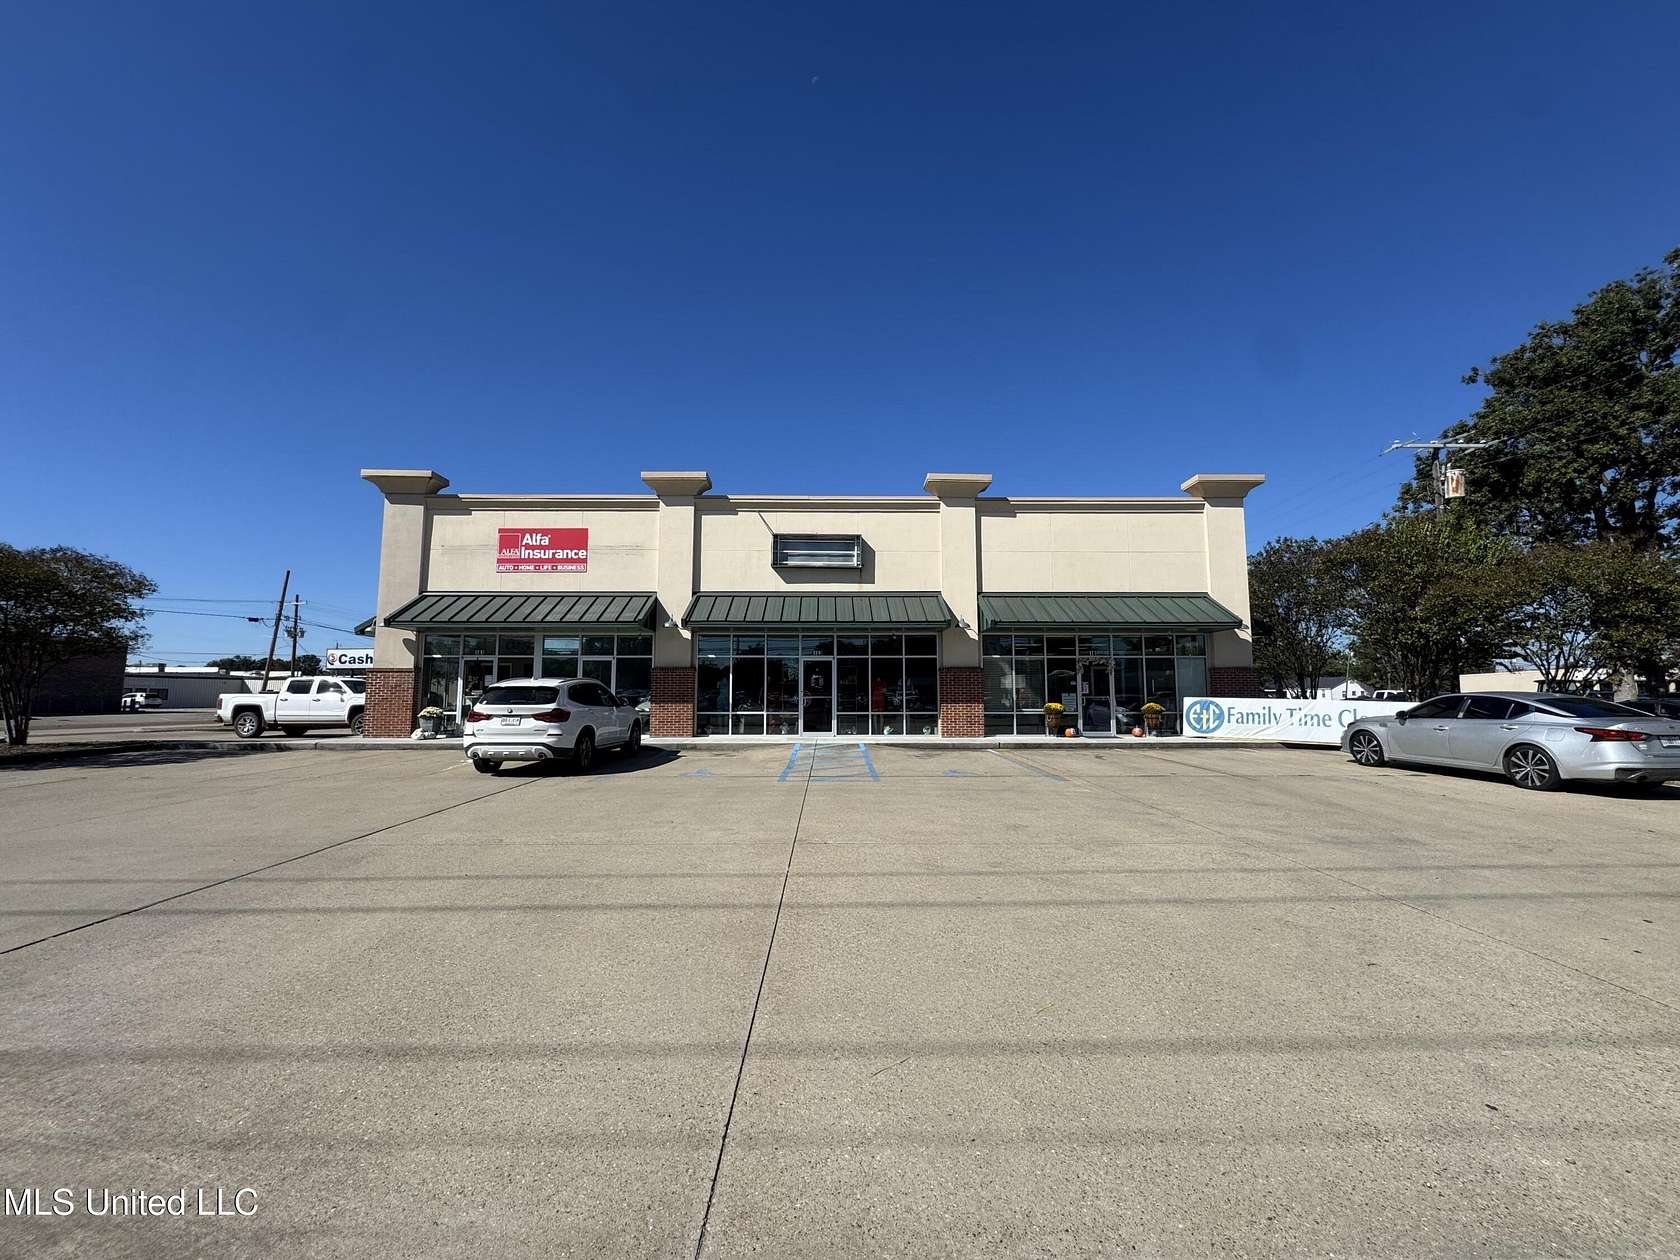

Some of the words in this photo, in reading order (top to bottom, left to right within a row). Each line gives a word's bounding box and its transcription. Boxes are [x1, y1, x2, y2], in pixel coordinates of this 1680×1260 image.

[522, 533, 549, 545] Alfa
[501, 548, 519, 556] ALFA
[520, 547, 586, 558] Insurance
[339, 653, 373, 664] Cash
[1227, 706, 1282, 725] Family
[1286, 707, 1332, 728] Time
[1338, 708, 1357, 727] Cl
